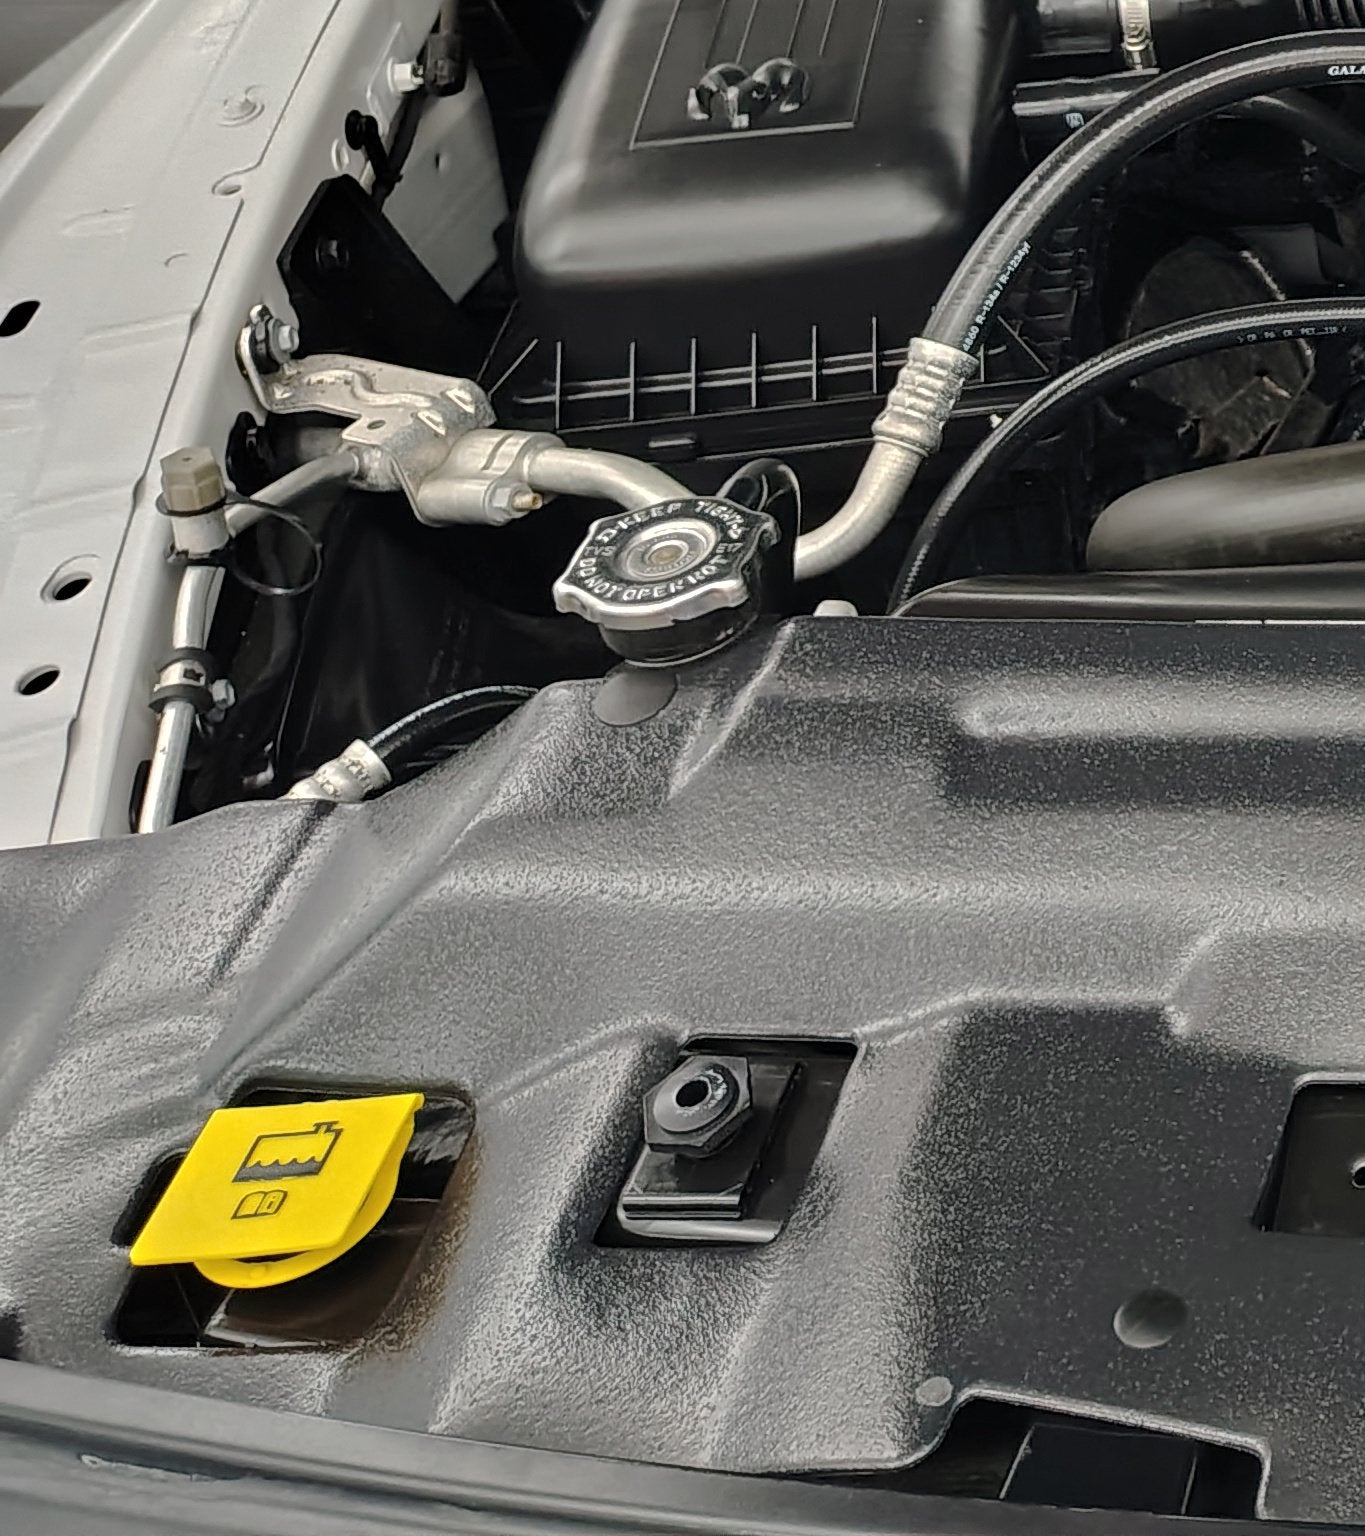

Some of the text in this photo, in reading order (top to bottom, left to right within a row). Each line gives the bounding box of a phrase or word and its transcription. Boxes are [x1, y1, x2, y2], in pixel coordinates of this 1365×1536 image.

[579, 557, 598, 577] DO
[584, 576, 624, 598] NOT
[622, 581, 685, 601] OPEN
